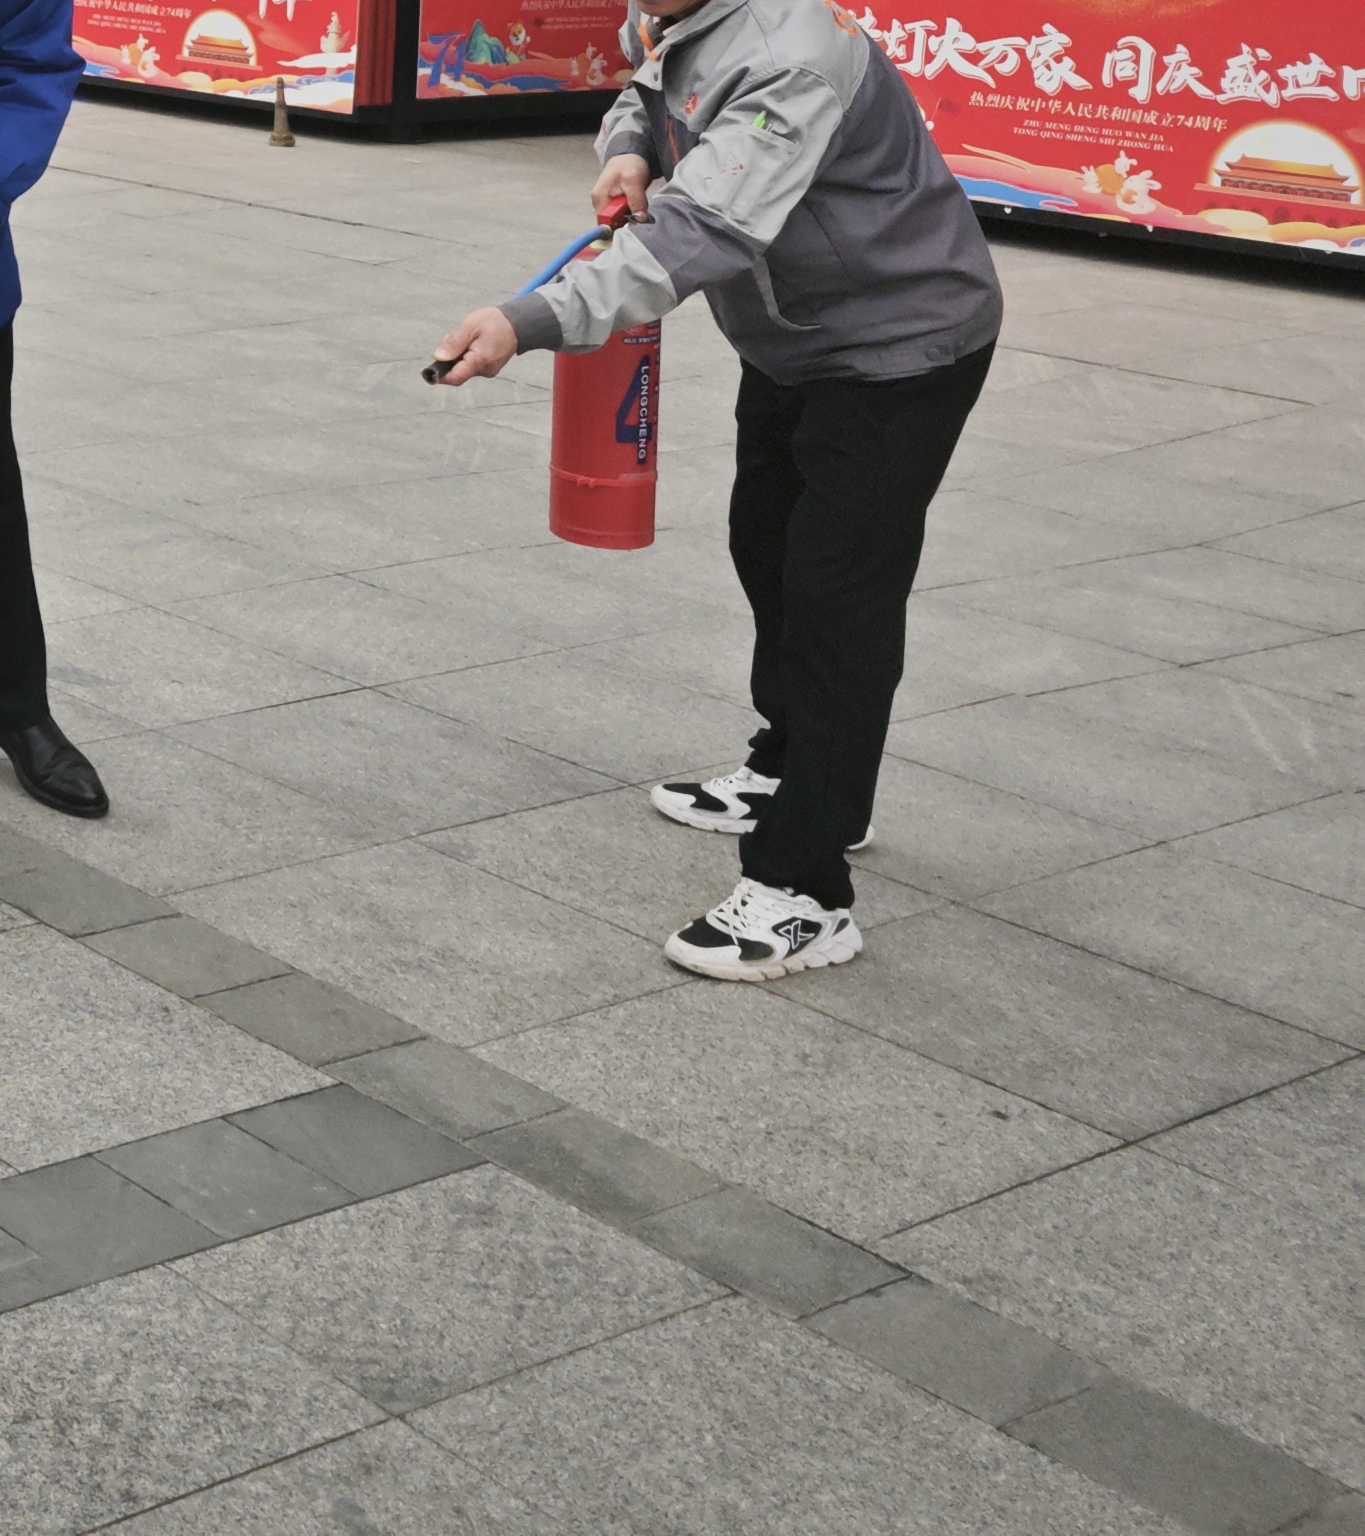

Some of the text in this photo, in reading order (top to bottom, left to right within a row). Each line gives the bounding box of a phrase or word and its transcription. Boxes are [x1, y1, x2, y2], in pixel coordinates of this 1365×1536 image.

[969, 91, 1228, 132] 热烈庆祝中华人民共和国成立74周年
[1013, 127, 1038, 136] TONG
[1040, 130, 1063, 139] QING
[1065, 134, 1097, 143] SHENG
[1117, 139, 1152, 150] ZHONG
[1023, 119, 1164, 142] ZHU MENG DENG HUO WAN JIA
[638, 365, 650, 460] LONGCHENG
